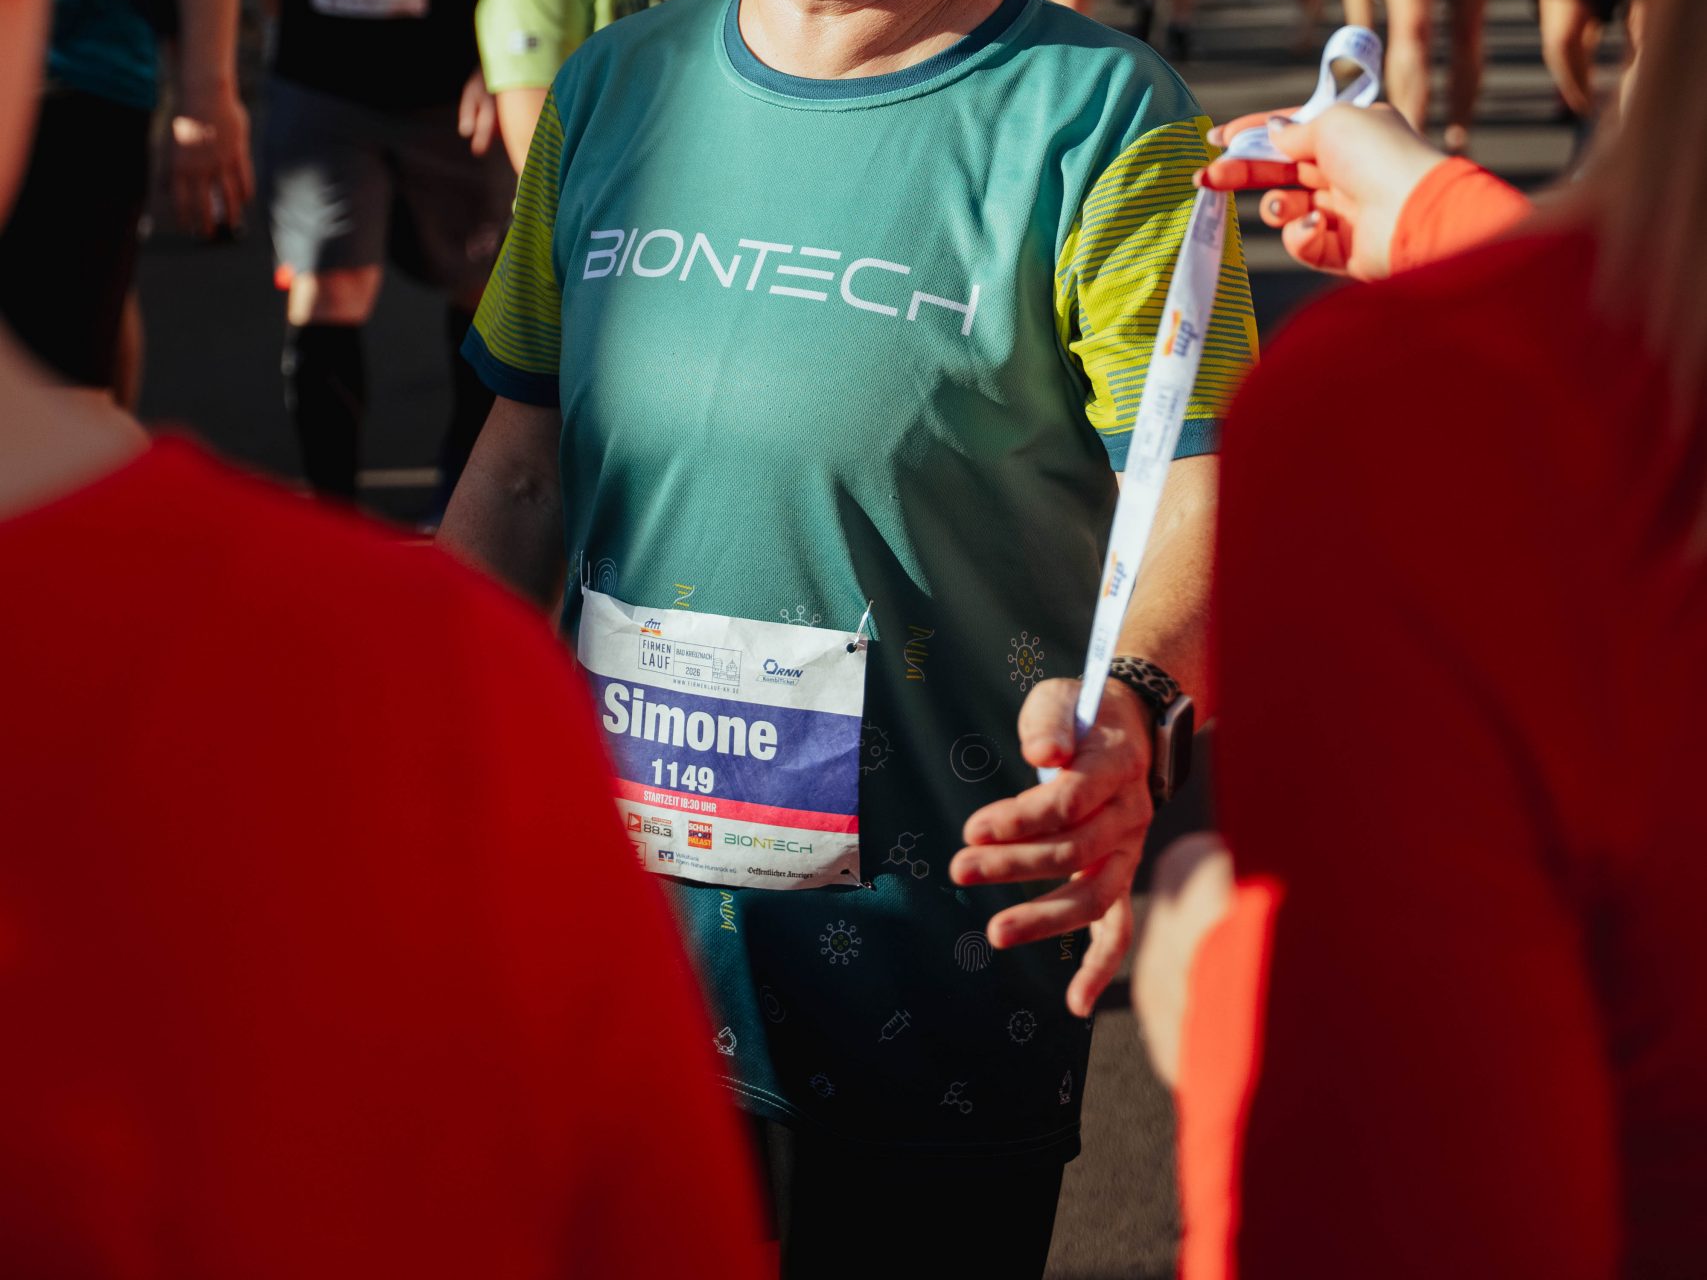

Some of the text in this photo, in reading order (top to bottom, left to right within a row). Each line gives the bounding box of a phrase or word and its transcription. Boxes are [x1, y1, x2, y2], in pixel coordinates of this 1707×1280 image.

[583, 227, 980, 337] BIONTECH
[644, 618, 662, 630] dm
[642, 639, 672, 654] FIRMEN
[676, 648, 685, 657] BAD
[642, 651, 671, 671] LAUF
[685, 666, 701, 677] 2026
[602, 682, 778, 761] Simone
[651, 758, 715, 794] 1149
[643, 790, 717, 813] STARTZEIT 18:30 UHR
[643, 823, 673, 837] 88.3
[688, 822, 712, 833] SCHUH
[724, 832, 814, 854] BIONTECH
